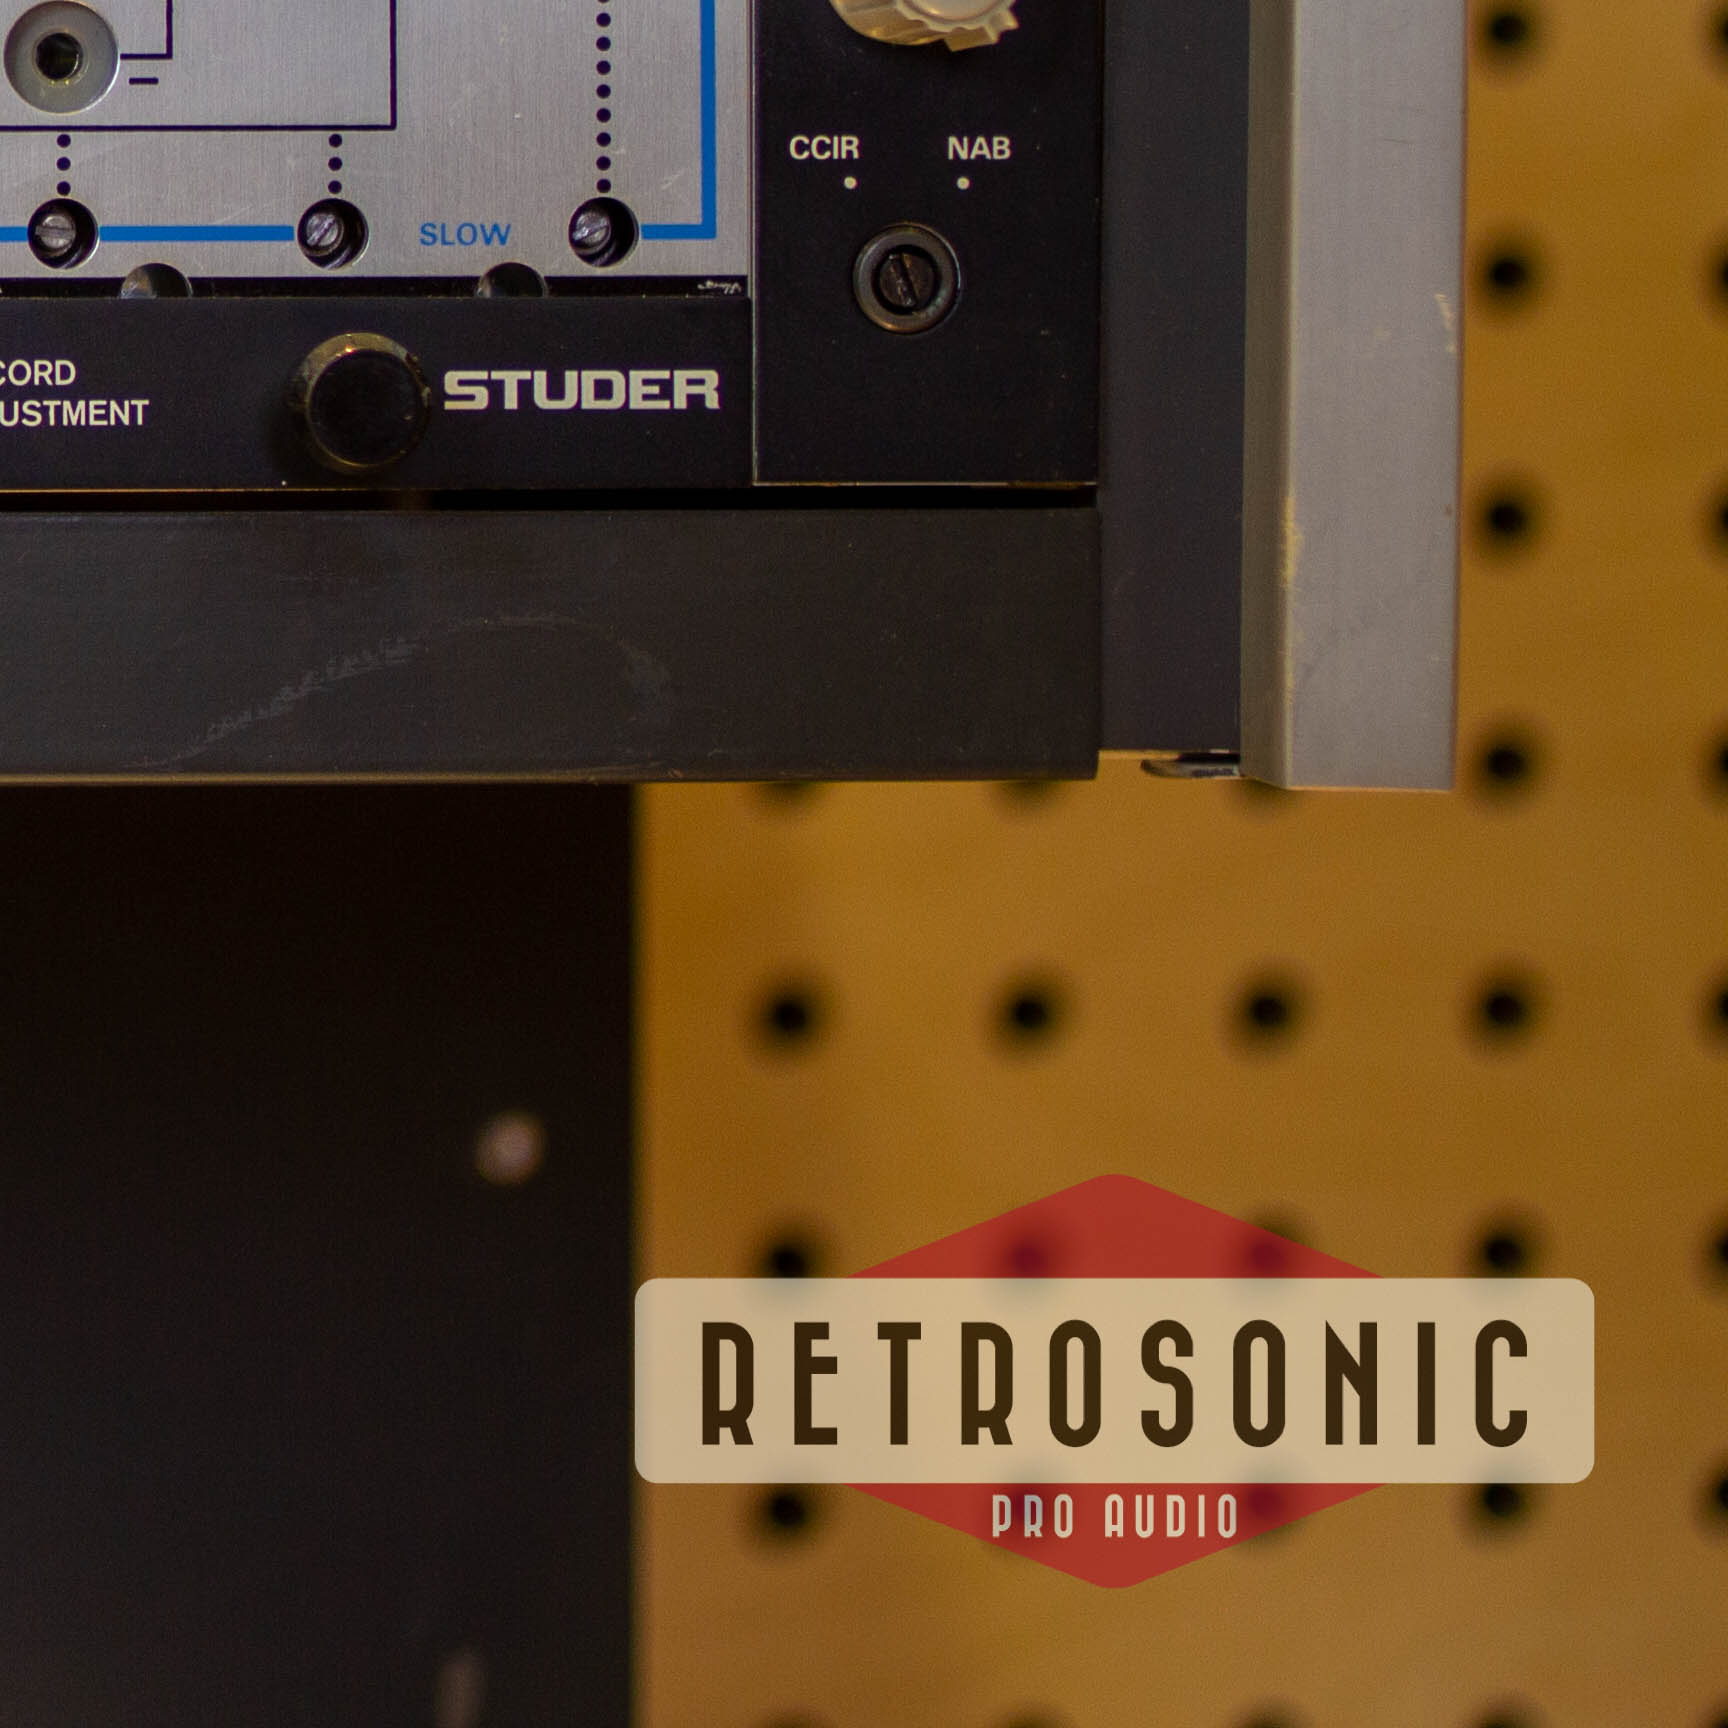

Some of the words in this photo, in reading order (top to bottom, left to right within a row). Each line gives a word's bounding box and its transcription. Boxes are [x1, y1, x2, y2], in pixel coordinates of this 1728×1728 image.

[789, 135, 860, 160] CCIR
[948, 136, 1011, 160] NAB
[419, 222, 511, 247] SLOW
[443, 369, 720, 410] STUDER
